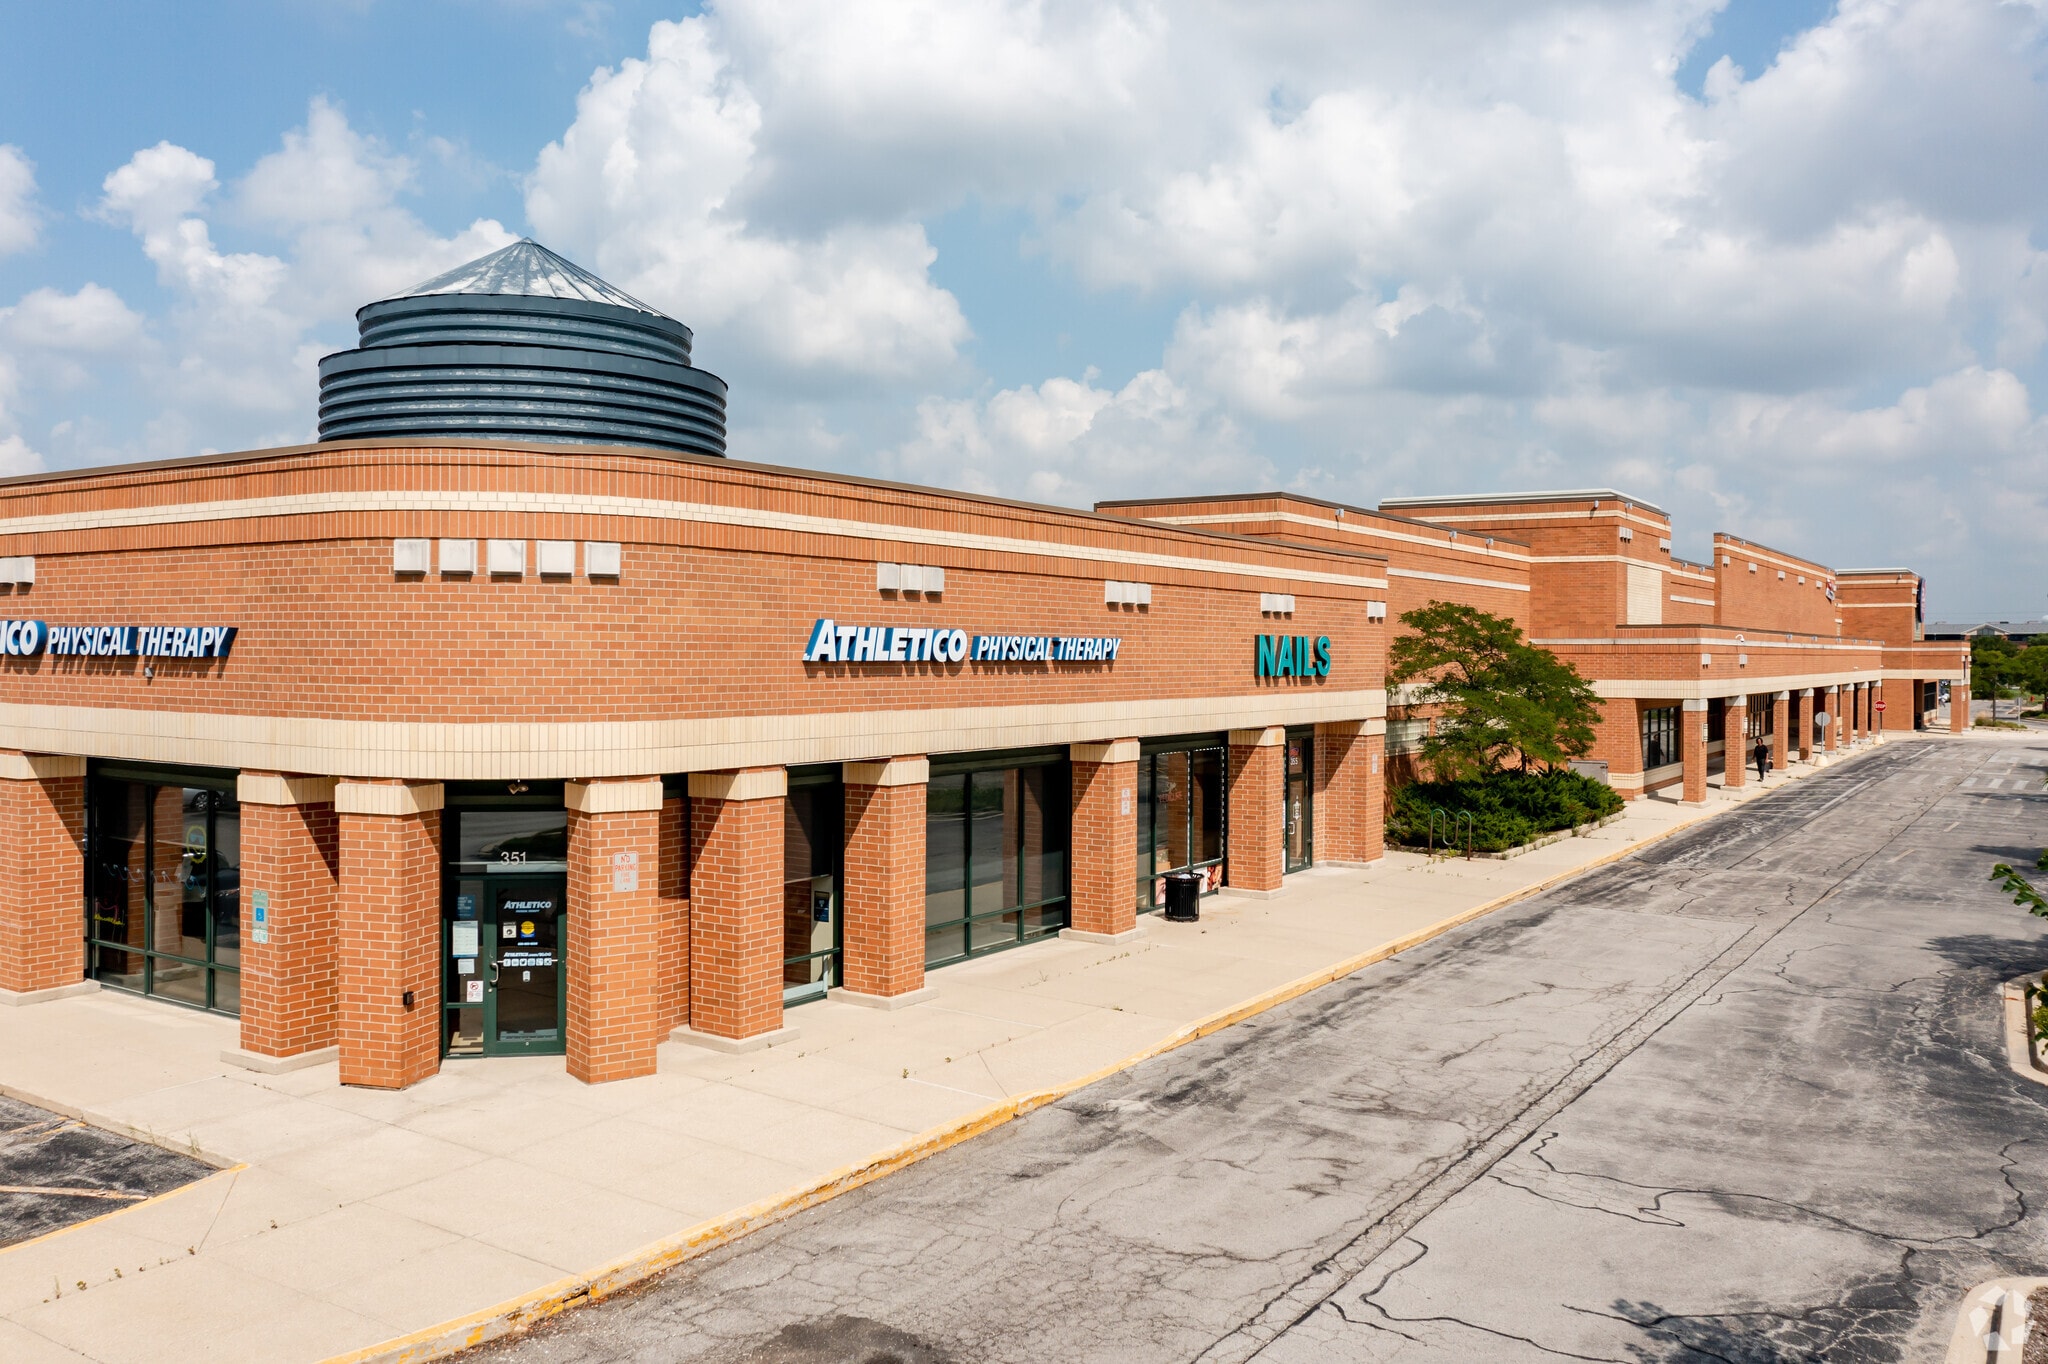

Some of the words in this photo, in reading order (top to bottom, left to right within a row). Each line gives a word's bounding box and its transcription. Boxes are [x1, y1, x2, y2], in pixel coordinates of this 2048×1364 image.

[0, 620, 40, 656] ICO
[47, 626, 132, 656] PHYSICAL
[136, 626, 229, 658] THERAPY
[802, 618, 968, 663] ATHLETICO
[974, 636, 1053, 662] PHYSICAL
[1056, 637, 1122, 661] THERAPY
[1256, 634, 1331, 677] NAILS
[500, 851, 526, 866] 351
[620, 855, 631, 863] NO
[614, 863, 637, 871] PARKING
[503, 900, 552, 909] ATHLETICO
